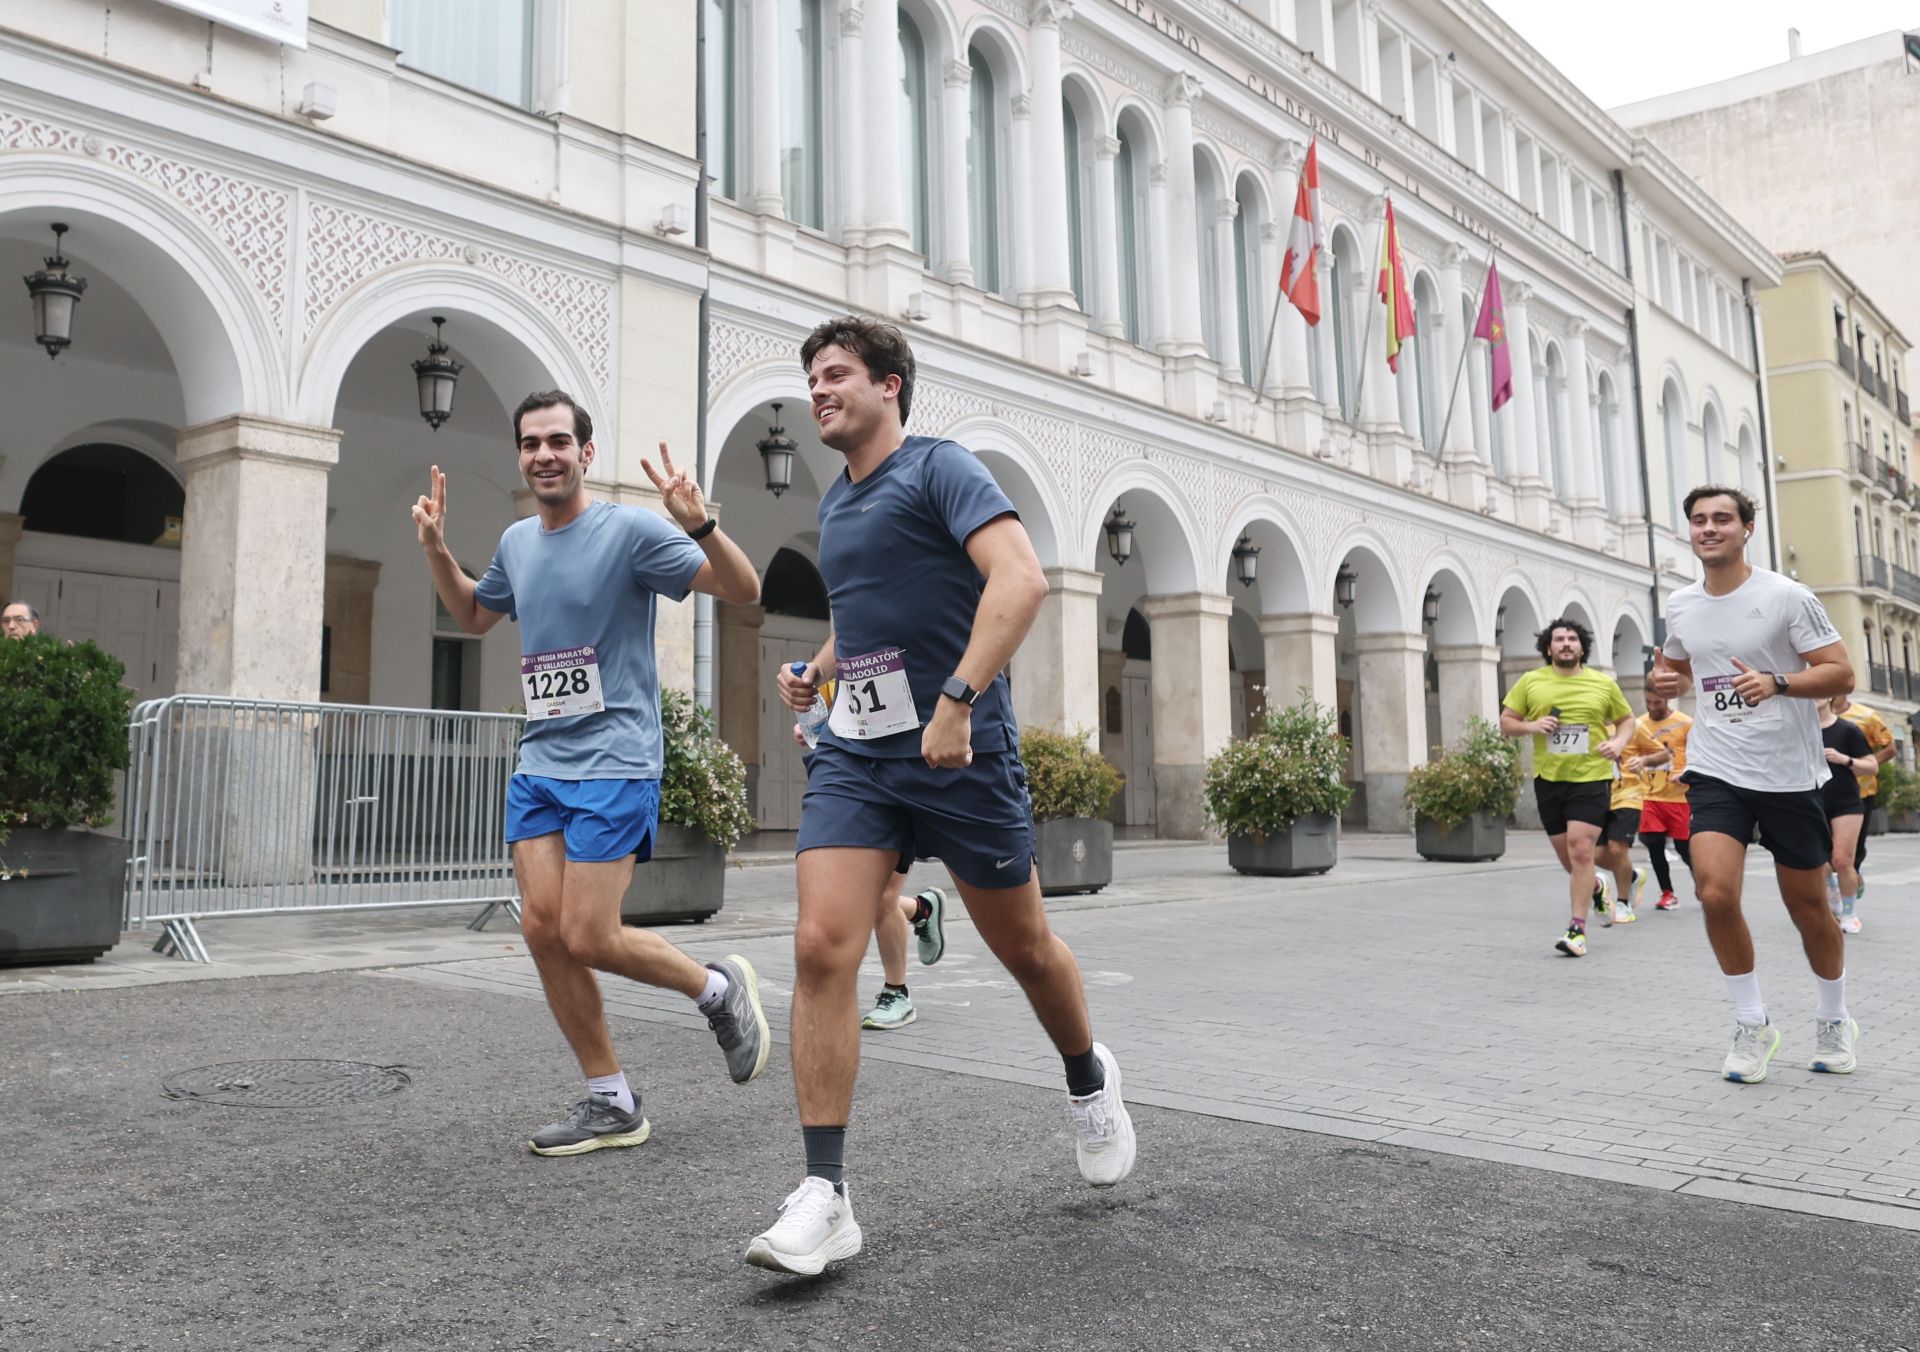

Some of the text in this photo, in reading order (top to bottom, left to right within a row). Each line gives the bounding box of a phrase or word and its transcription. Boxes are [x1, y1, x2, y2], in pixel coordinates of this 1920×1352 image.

[533, 657, 585, 672] DE VALLADOLID
[536, 653, 557, 663] MEDIA
[851, 650, 899, 670] MARATÓN
[527, 668, 590, 701] 1228
[1714, 689, 1760, 712] 84
[1552, 732, 1580, 745] 377
